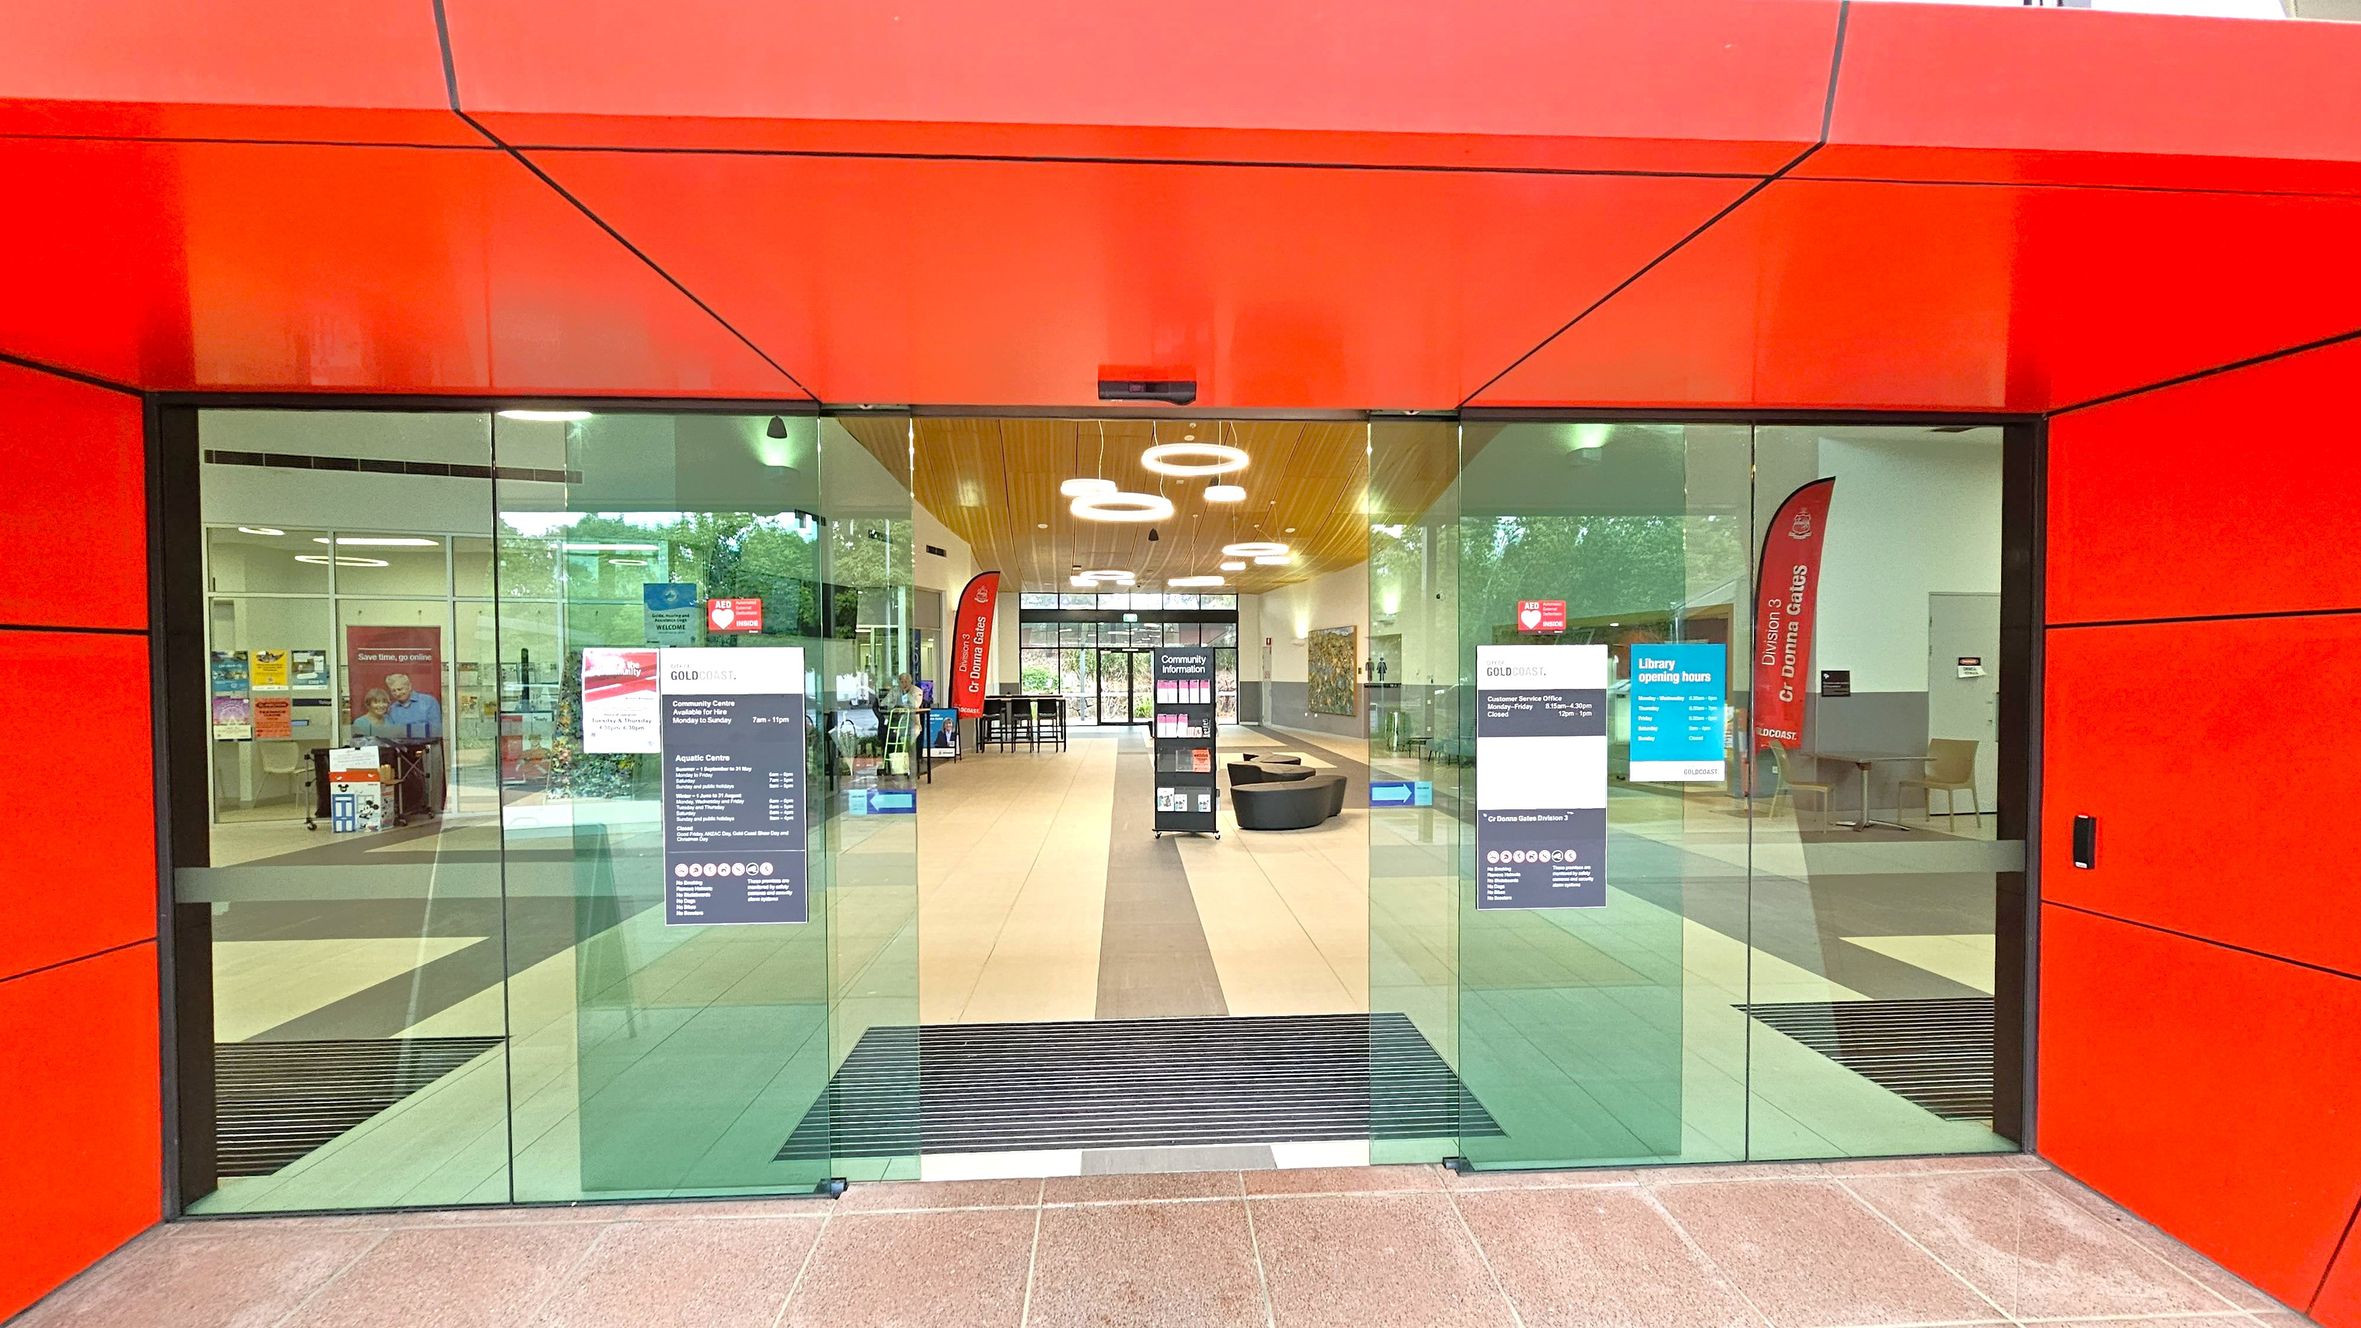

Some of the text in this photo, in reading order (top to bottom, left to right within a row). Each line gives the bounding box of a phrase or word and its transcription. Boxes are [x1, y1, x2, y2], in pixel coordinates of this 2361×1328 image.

[1525, 602, 1539, 610] AED
[1762, 599, 1781, 665] Division 3
[1779, 564, 1807, 702] Cr Donna Gates
[399, 655, 408, 663] go
[959, 641, 970, 672] Division
[969, 616, 986, 692] Cr Donna Gates
[1161, 655, 1206, 665] Community
[1638, 658, 1676, 671] Library
[1162, 665, 1205, 674] Information
[1638, 671, 1711, 684] opening hours
[708, 717, 731, 725] Sunday
[676, 755, 704, 763] Aquatic
